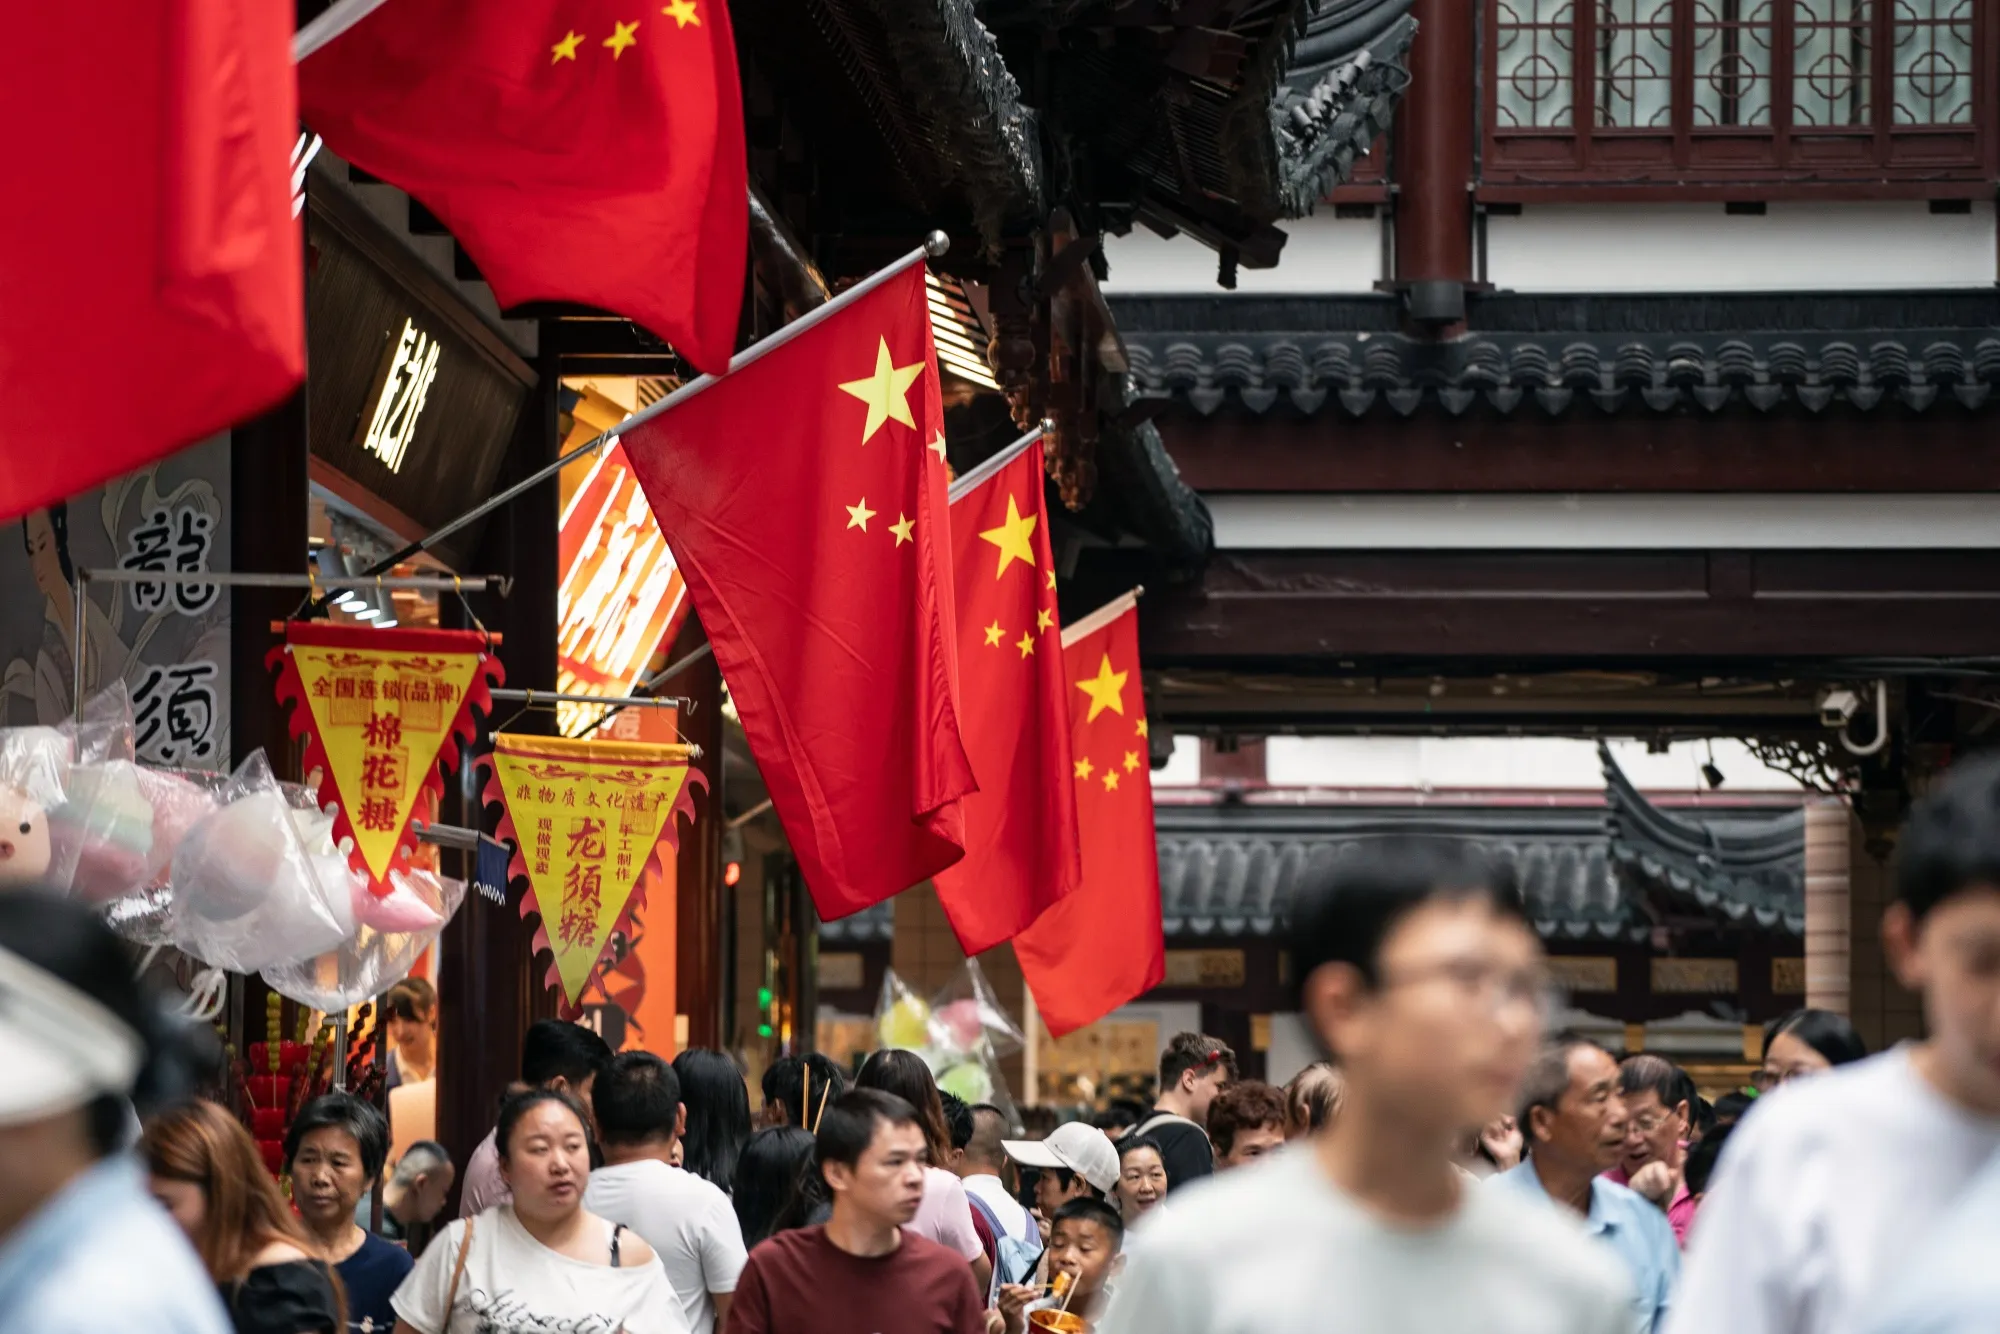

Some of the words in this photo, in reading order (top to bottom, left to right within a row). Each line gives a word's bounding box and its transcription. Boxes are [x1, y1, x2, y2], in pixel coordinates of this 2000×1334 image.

[356, 711, 402, 832] 棉花糖
[516, 783, 669, 812] 非物质文化遗产
[534, 817, 553, 876] 现做现卖
[615, 822, 634, 882] 手工制作
